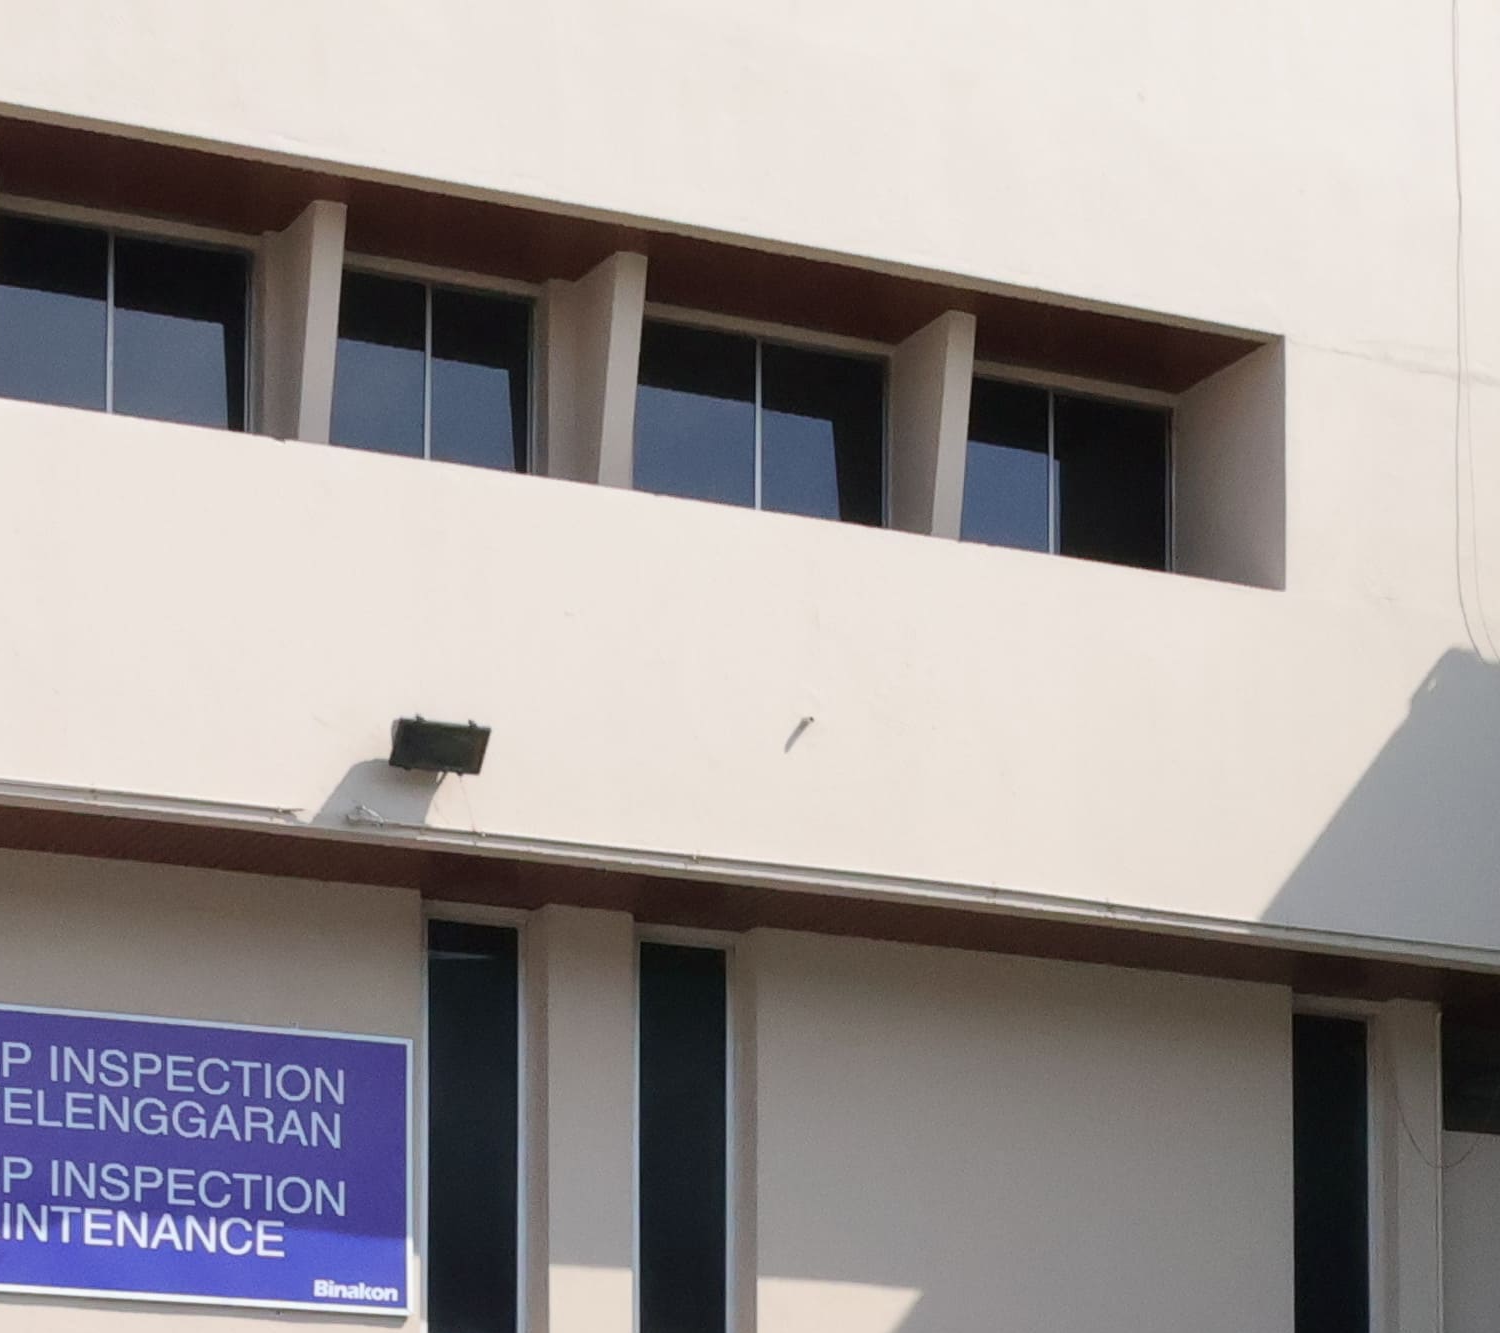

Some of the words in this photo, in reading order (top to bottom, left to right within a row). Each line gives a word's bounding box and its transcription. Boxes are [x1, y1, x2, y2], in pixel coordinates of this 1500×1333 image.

[50, 1047, 346, 1105] INSPECTION
[50, 1159, 346, 1217] INSPECTION
[313, 1279, 398, 1303] Binakon
